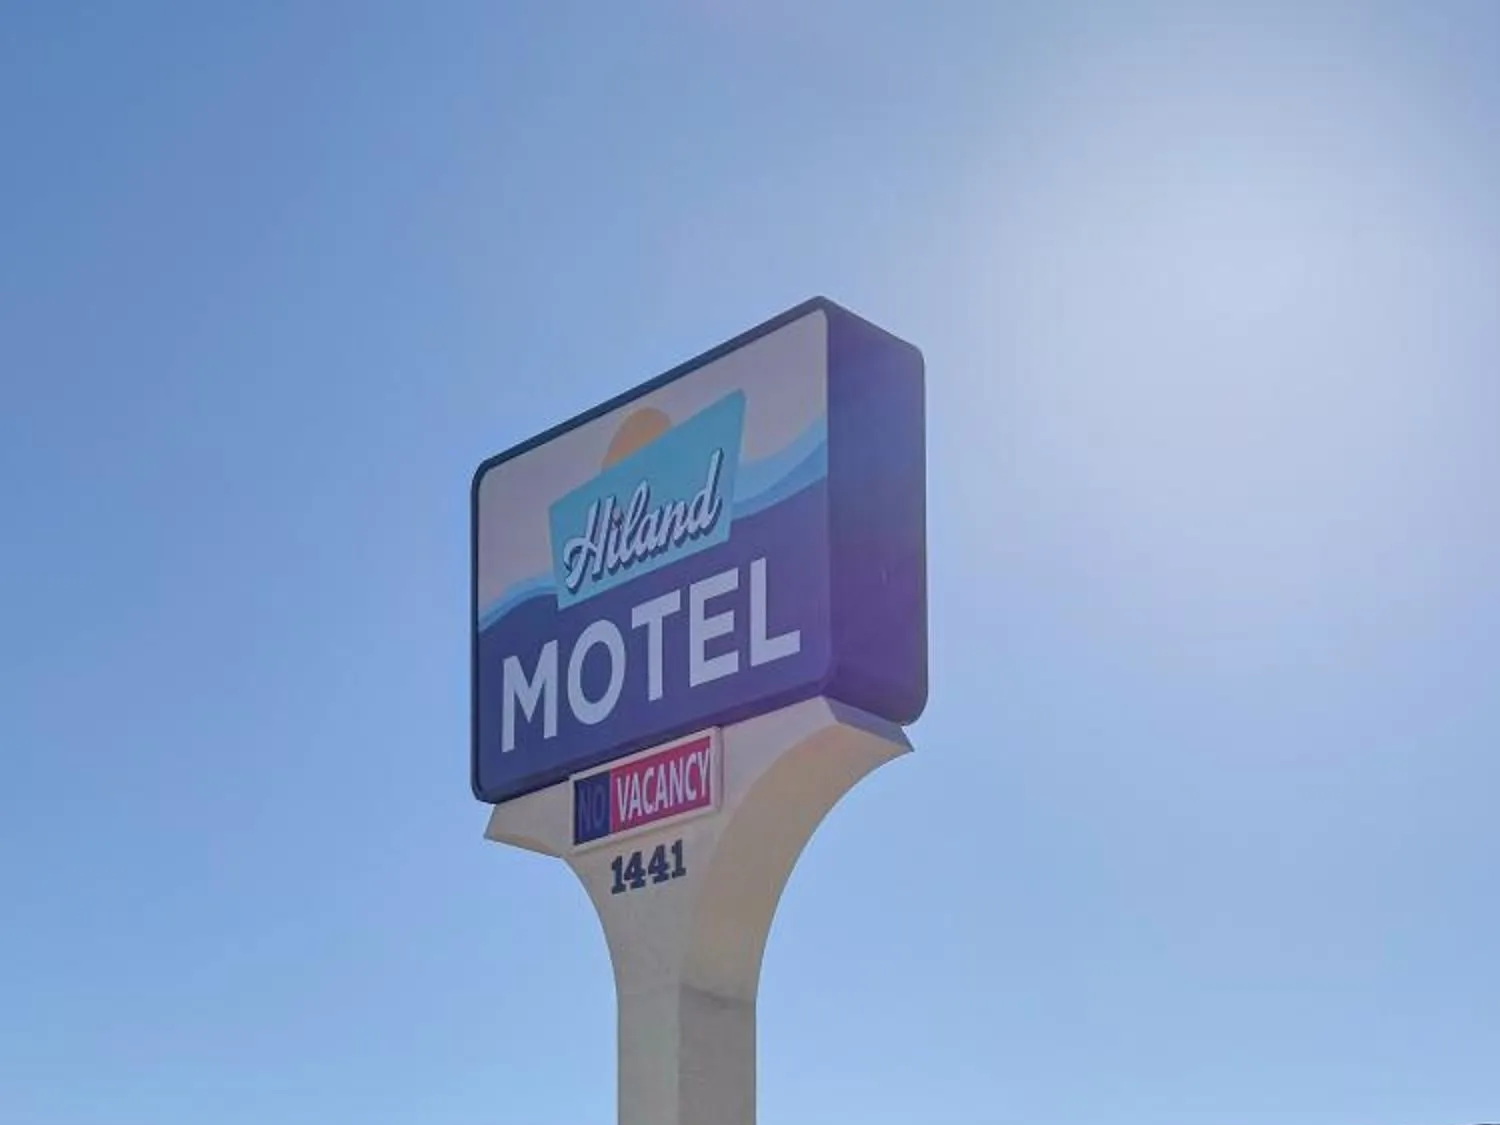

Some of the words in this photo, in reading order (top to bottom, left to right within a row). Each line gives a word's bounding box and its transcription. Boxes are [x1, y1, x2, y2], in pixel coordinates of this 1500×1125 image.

[563, 448, 724, 595] Hiland
[501, 557, 801, 752] MOTEL
[578, 784, 607, 834] NO
[617, 748, 710, 822] VACANCY
[611, 839, 687, 894] 1441
